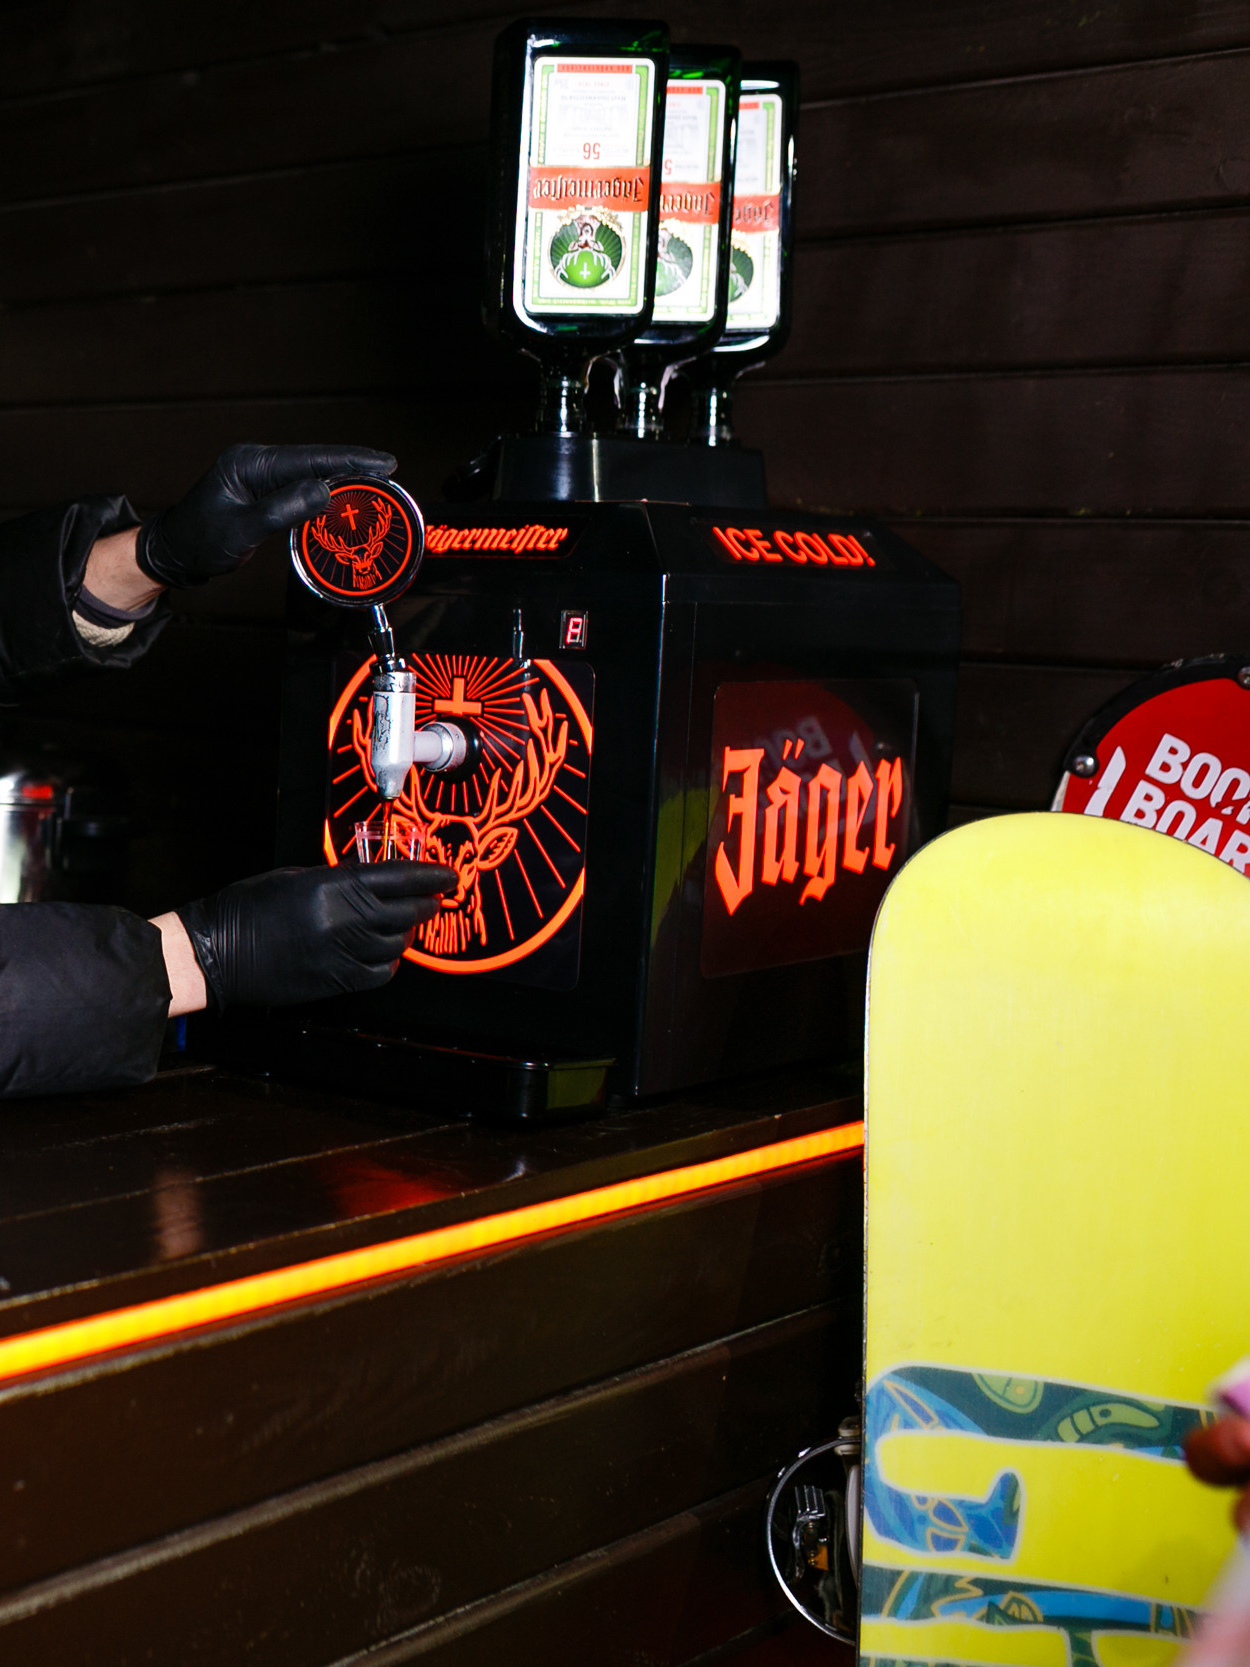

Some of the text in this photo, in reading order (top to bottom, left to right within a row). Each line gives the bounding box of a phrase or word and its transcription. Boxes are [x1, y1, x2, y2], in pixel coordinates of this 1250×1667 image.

[583, 142, 601, 160] 56
[664, 159, 673, 176] 5
[712, 526, 876, 567] ICE COLD!
[713, 739, 903, 915] Jäger
